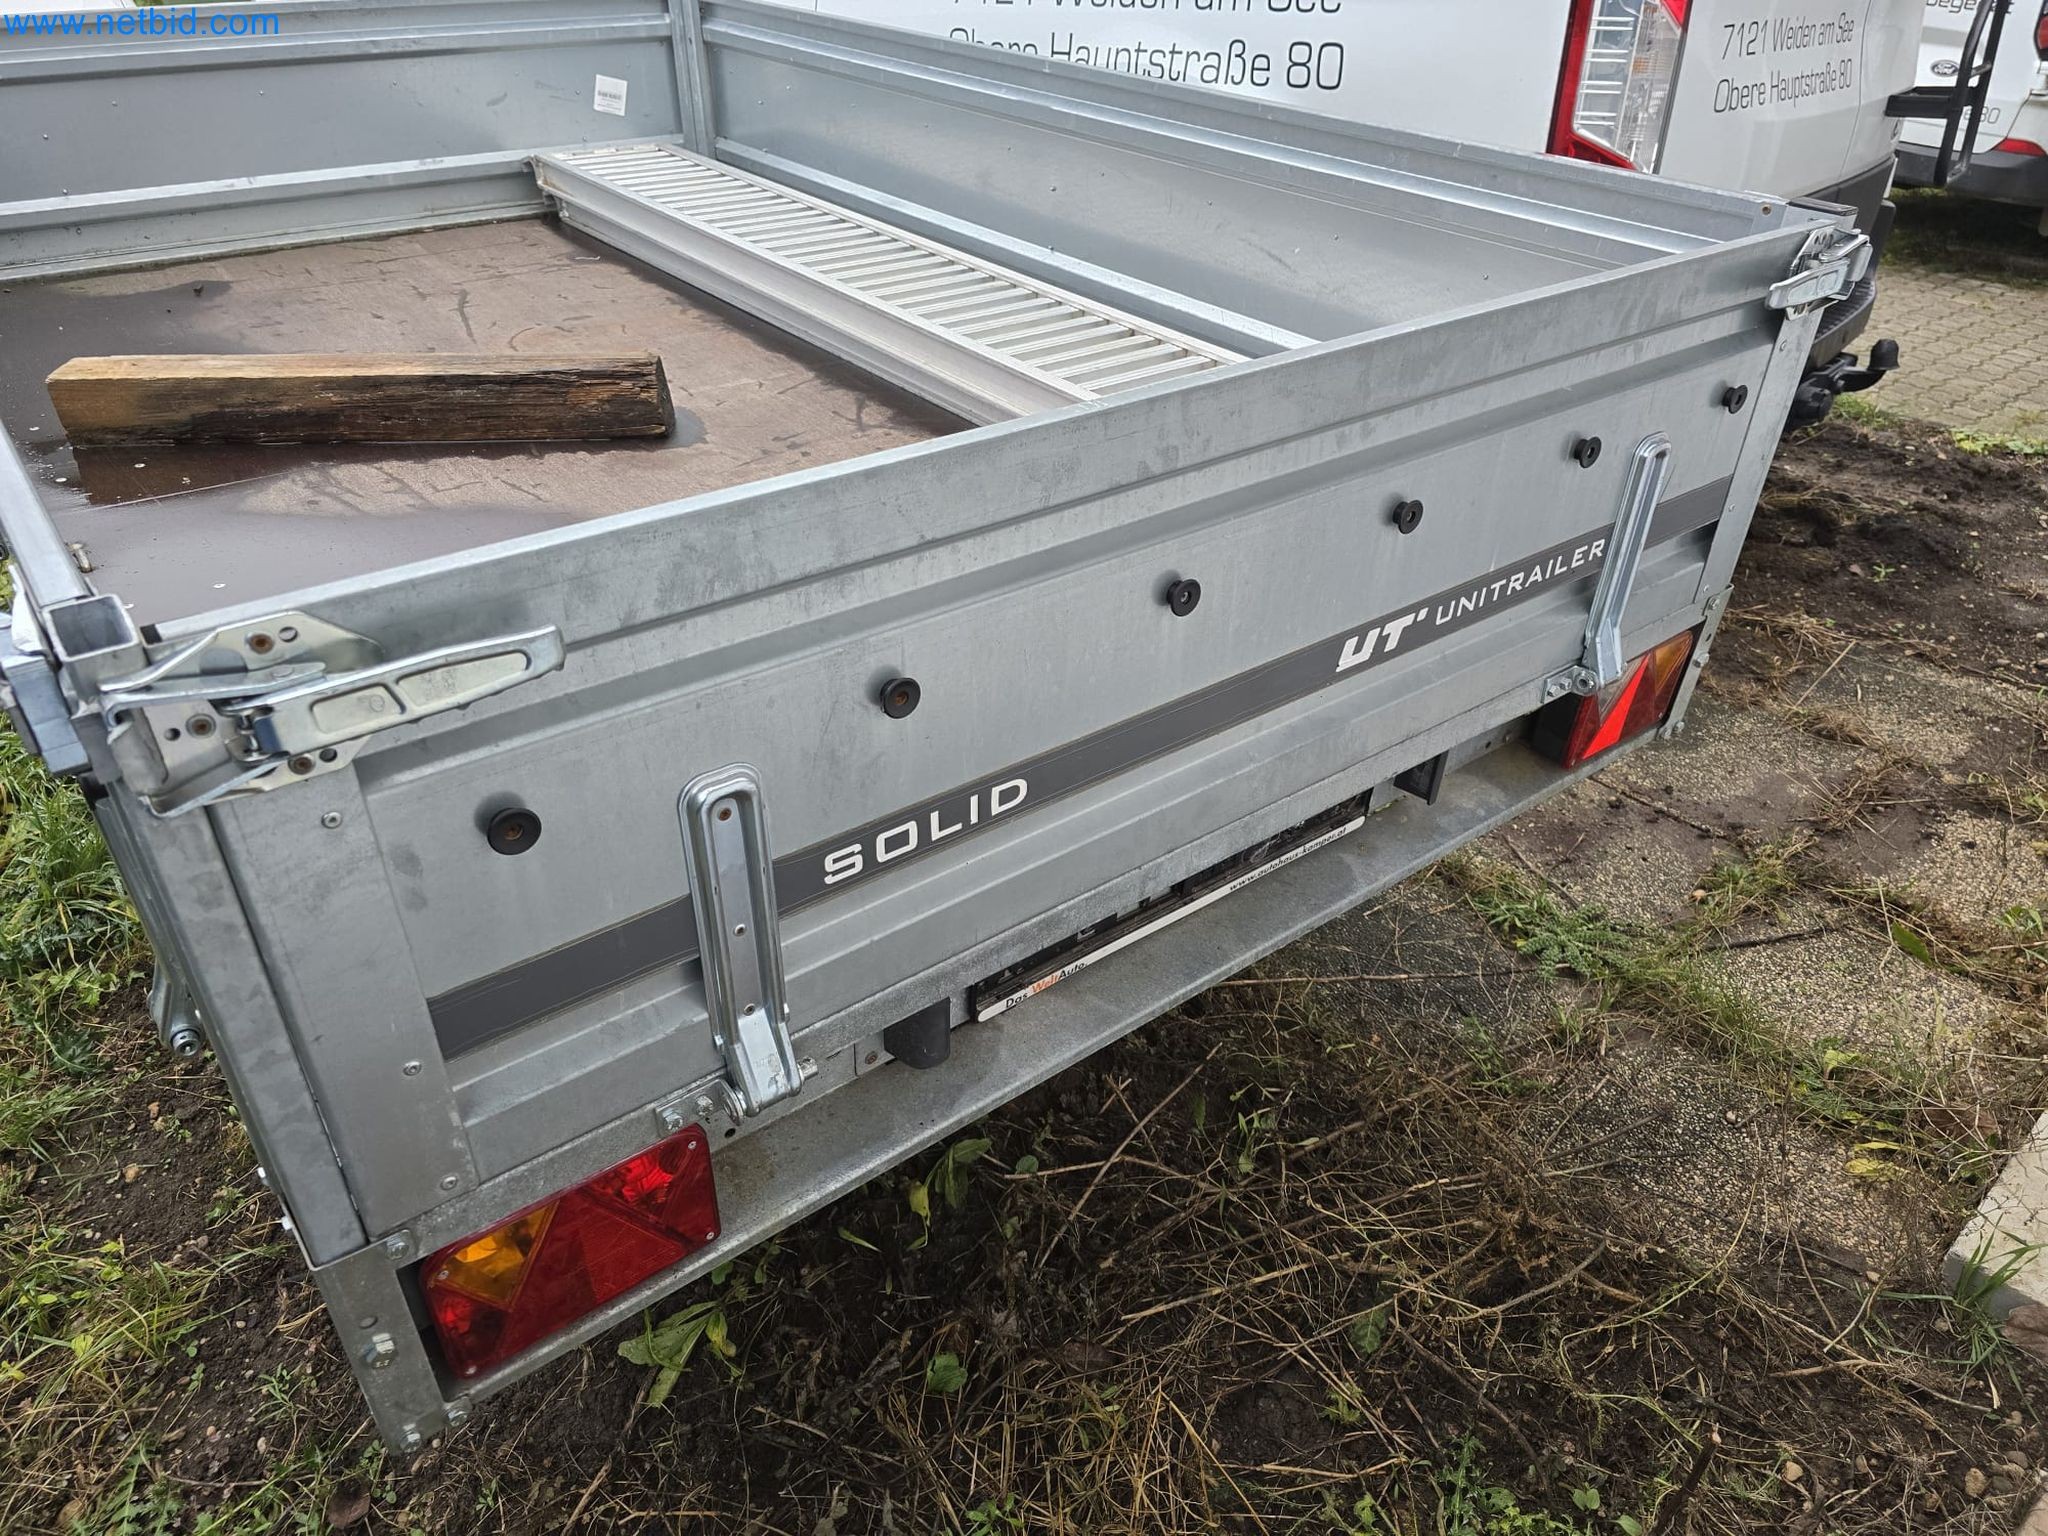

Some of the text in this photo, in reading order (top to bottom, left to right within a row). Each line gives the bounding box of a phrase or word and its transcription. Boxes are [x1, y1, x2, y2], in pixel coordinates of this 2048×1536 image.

[1721, 12, 1855, 60] 7121 Weiden am See
[1286, 41, 1345, 91] 80
[1713, 58, 1853, 113] Obere Hauptstraße 80
[1435, 538, 1606, 626] UNITRAILER
[823, 778, 1029, 885] SOLID
[1005, 992, 1028, 1009] Das
